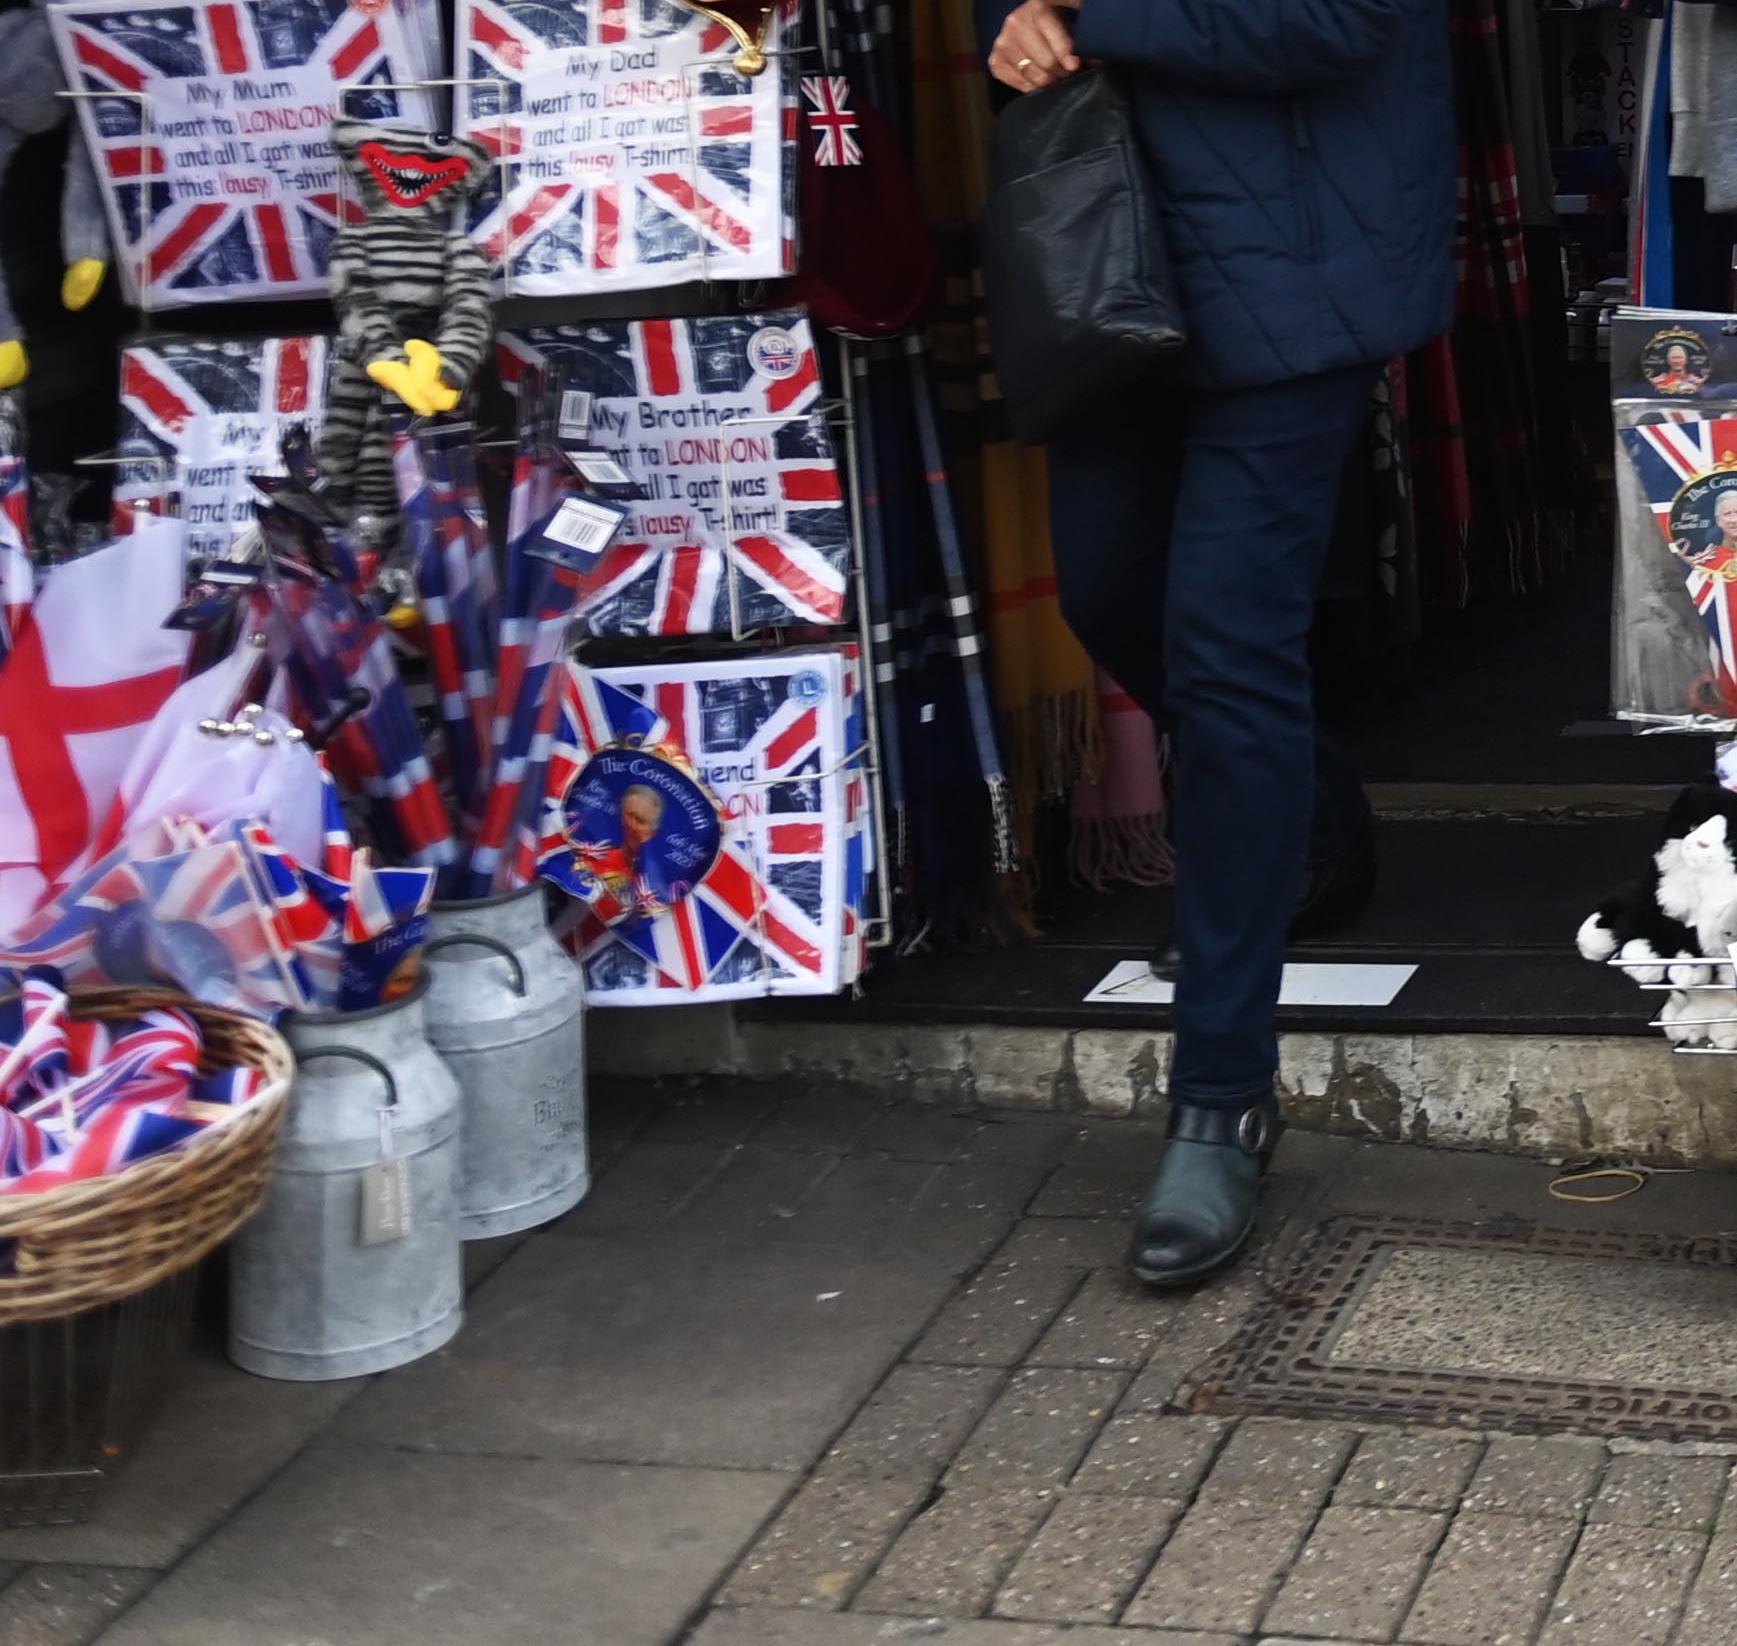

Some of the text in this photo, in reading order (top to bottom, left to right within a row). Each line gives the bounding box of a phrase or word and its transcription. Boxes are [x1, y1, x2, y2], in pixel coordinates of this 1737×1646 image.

[565, 45, 657, 81] My Dad
[186, 79, 297, 109] My Mum
[526, 77, 693, 116] went to LONDON
[158, 118, 206, 139] went
[213, 116, 234, 135] to
[532, 123, 566, 148] and
[570, 119, 592, 141] all
[652, 115, 688, 135] was
[174, 141, 293, 169] and all got
[526, 157, 564, 178] this
[175, 171, 272, 199] this lousy
[637, 400, 753, 429] Brother
[640, 443, 661, 466] to
[664, 437, 771, 467] LONDON
[687, 475, 768, 507] got was
[1684, 482, 1711, 505] The
[640, 515, 695, 542] lousy
[629, 758, 711, 831] Coronation
